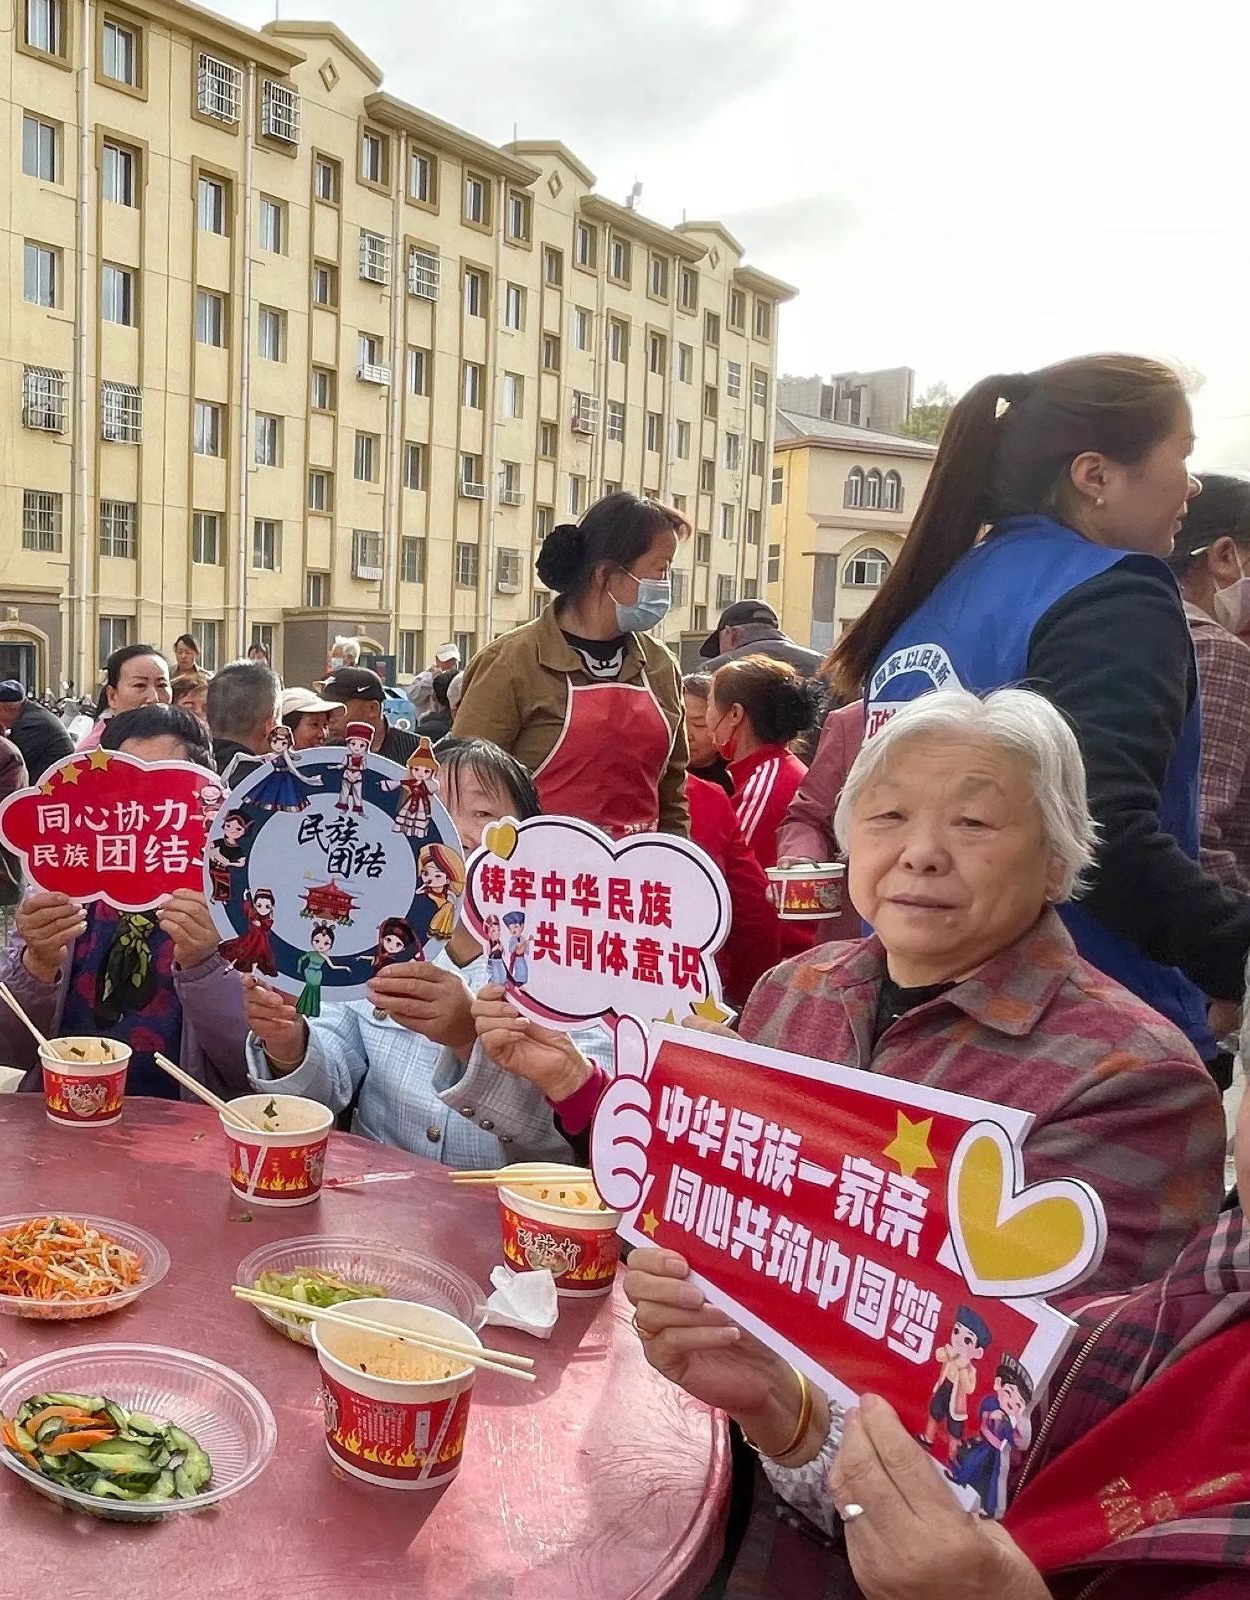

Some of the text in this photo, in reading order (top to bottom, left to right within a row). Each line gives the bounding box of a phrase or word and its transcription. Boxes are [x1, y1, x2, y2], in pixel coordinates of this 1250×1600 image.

[36, 799, 189, 835] 同心协力
[297, 813, 360, 855] 民族
[32, 833, 190, 874] 民族团结
[327, 841, 387, 879] 团结
[479, 863, 673, 929] 铸牢中华民族
[532, 920, 703, 994] 共同体意识
[656, 1084, 931, 1258] 中华民族一家亲
[662, 1163, 943, 1365] 同心共筑中国梦
